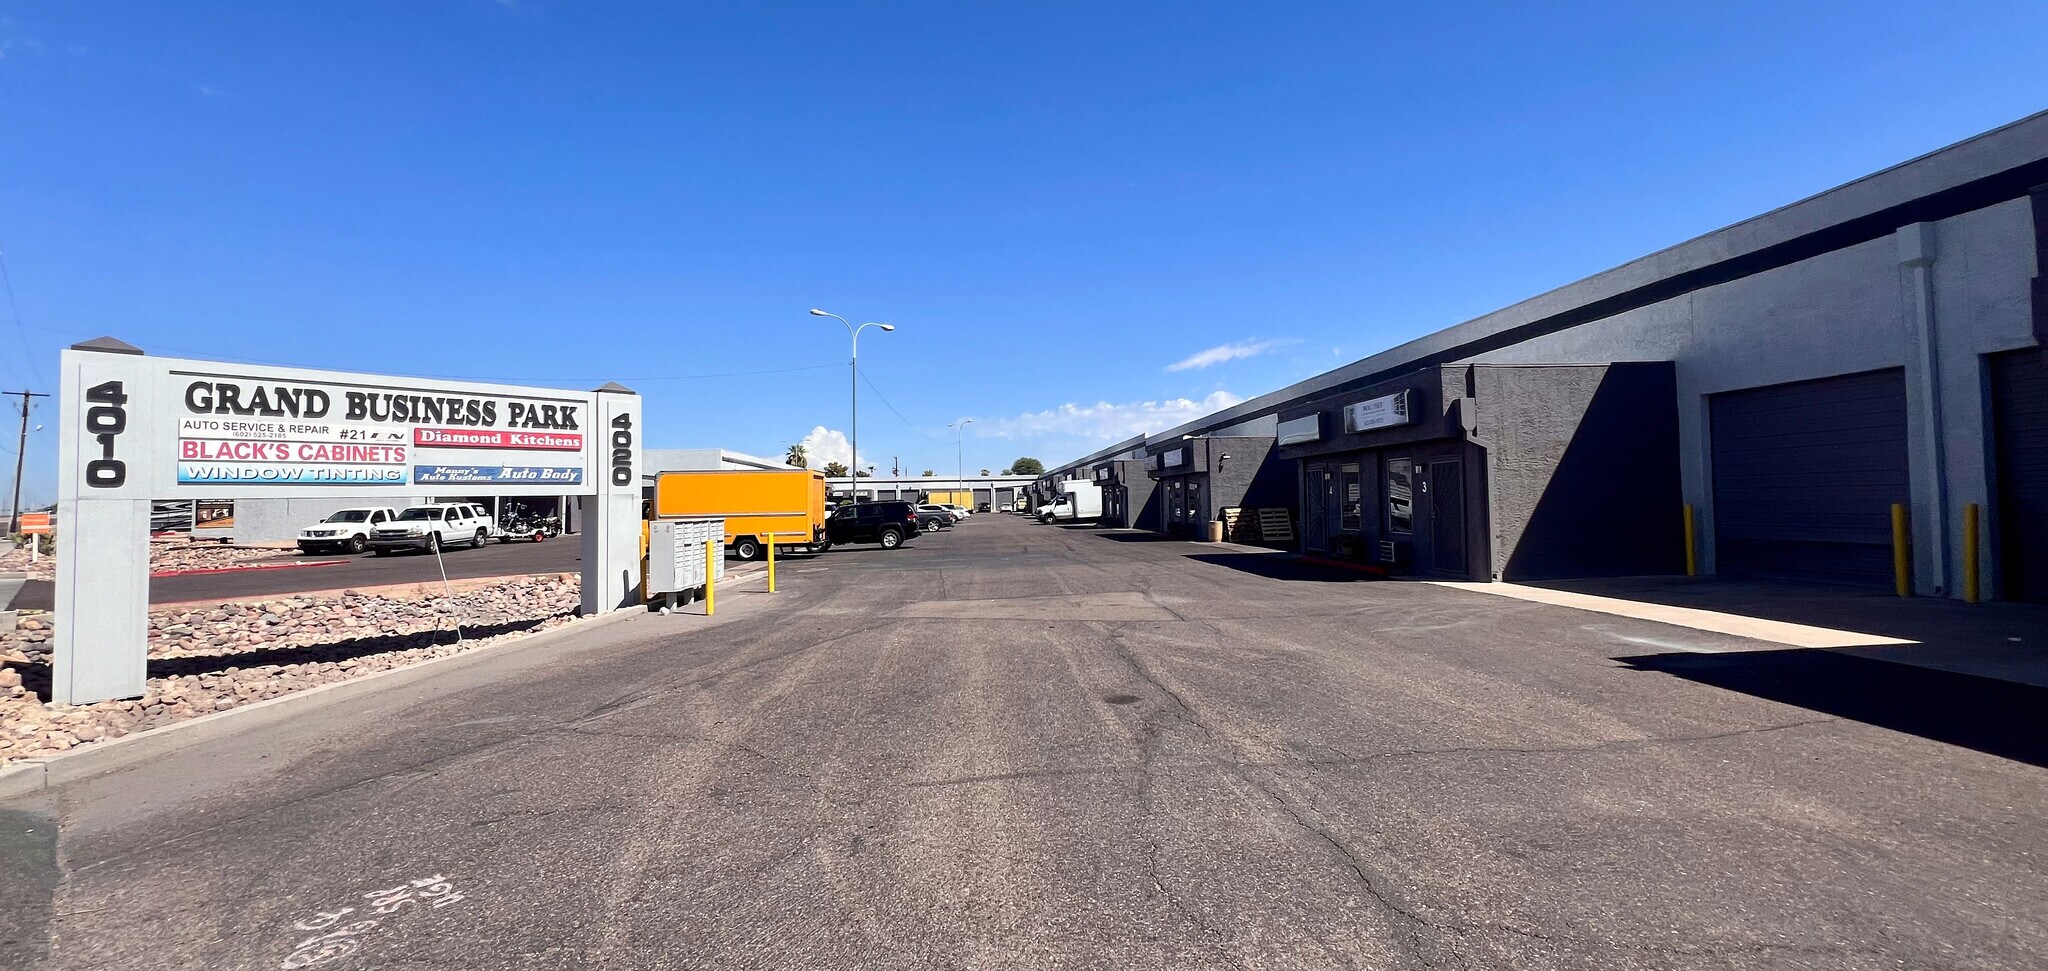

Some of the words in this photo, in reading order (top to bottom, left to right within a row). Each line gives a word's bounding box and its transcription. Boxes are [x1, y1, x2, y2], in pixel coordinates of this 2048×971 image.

[185, 381, 331, 419] GRAND
[345, 391, 497, 427] BUSINESS
[508, 402, 579, 430] PARK
[86, 380, 128, 488] 4010
[183, 420, 219, 430] AUTO
[223, 421, 275, 433] SERVICE
[278, 424, 286, 433] &
[289, 424, 330, 435] REPAIR
[340, 429, 366, 440] #21
[420, 429, 502, 445] Diamond
[510, 434, 581, 447] Kitchens
[182, 441, 290, 461] BLACK'S
[298, 444, 406, 463] CABINETS
[611, 413, 632, 487] 4020
[186, 466, 305, 480] WINDOW
[309, 468, 401, 481] TINTING
[420, 473, 446, 481] Auto
[448, 473, 493, 481] Kustoms
[434, 467, 480, 476] Manny's
[498, 467, 538, 480] Auto
[540, 467, 579, 482] Body
[1422, 482, 1427, 493] 3
